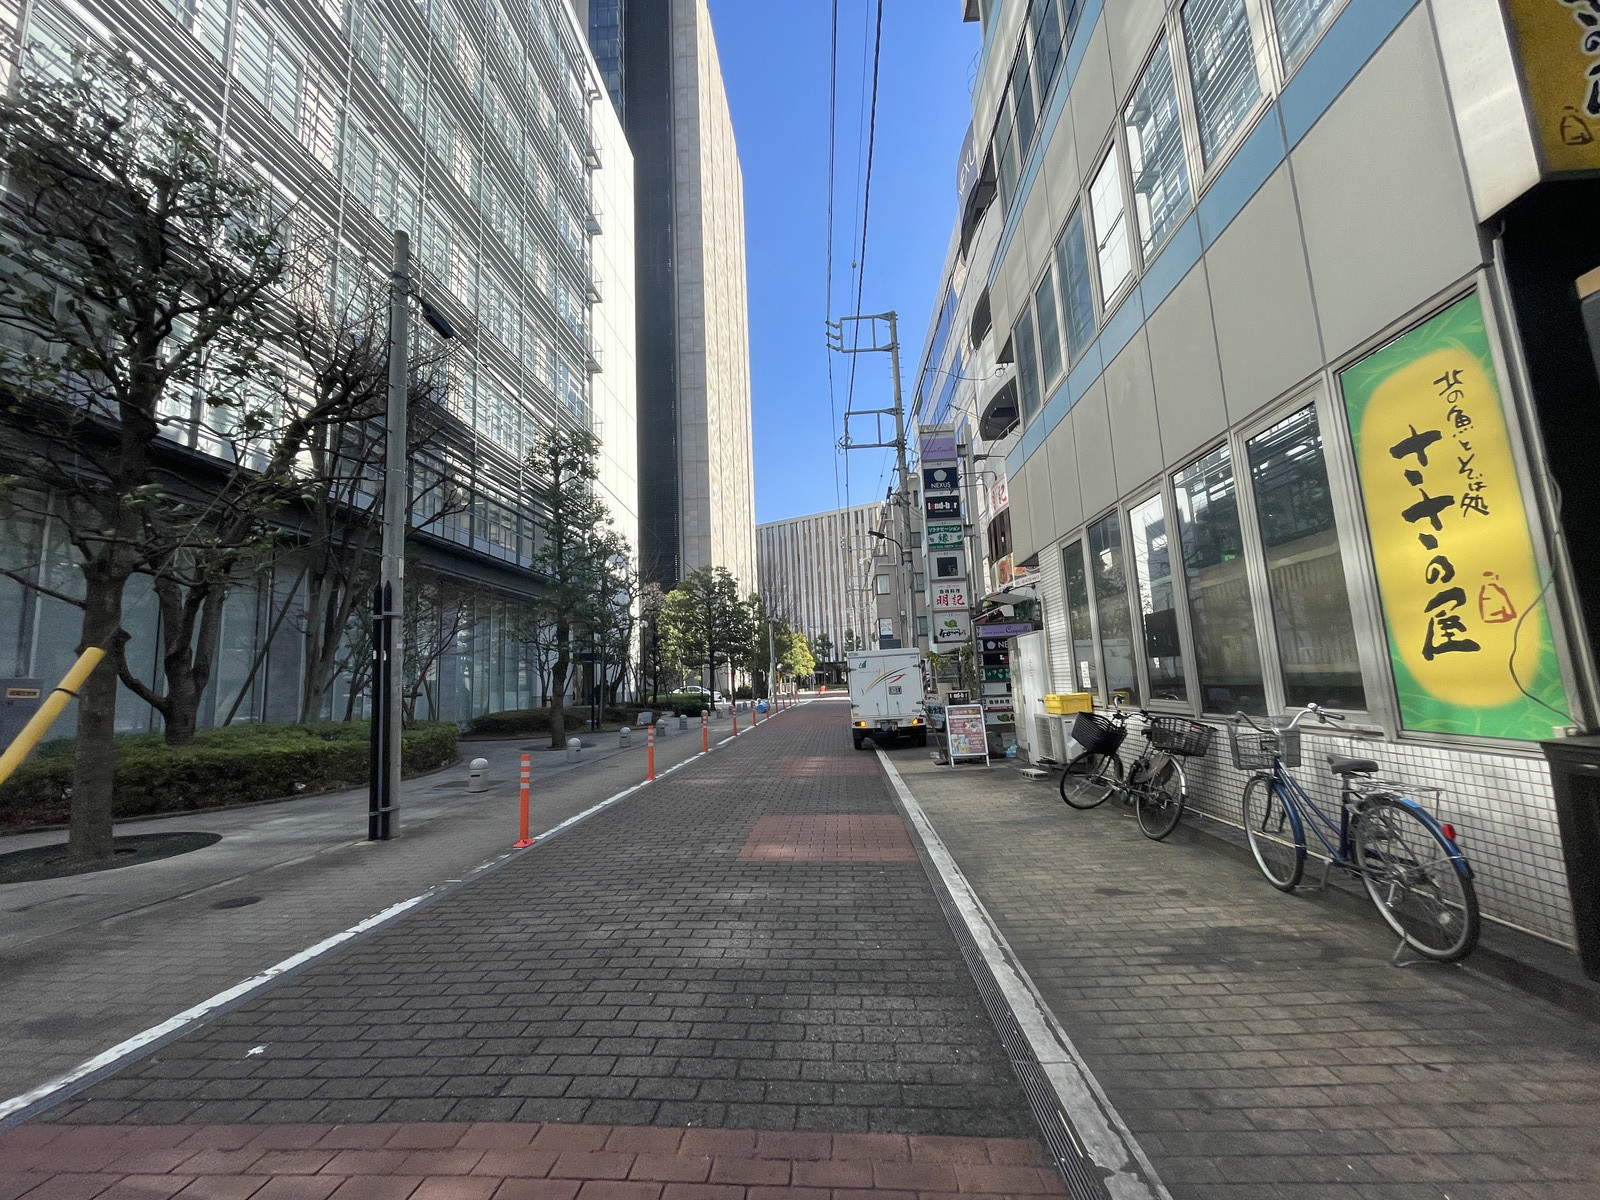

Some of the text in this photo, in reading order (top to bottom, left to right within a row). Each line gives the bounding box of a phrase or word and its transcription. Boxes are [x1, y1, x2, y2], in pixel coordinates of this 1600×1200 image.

[1433, 369, 1490, 517] 北の魚とそば処
[930, 481, 952, 489] NEXUS
[1389, 424, 1482, 662] ささの屋
[936, 594, 966, 607] 明記
